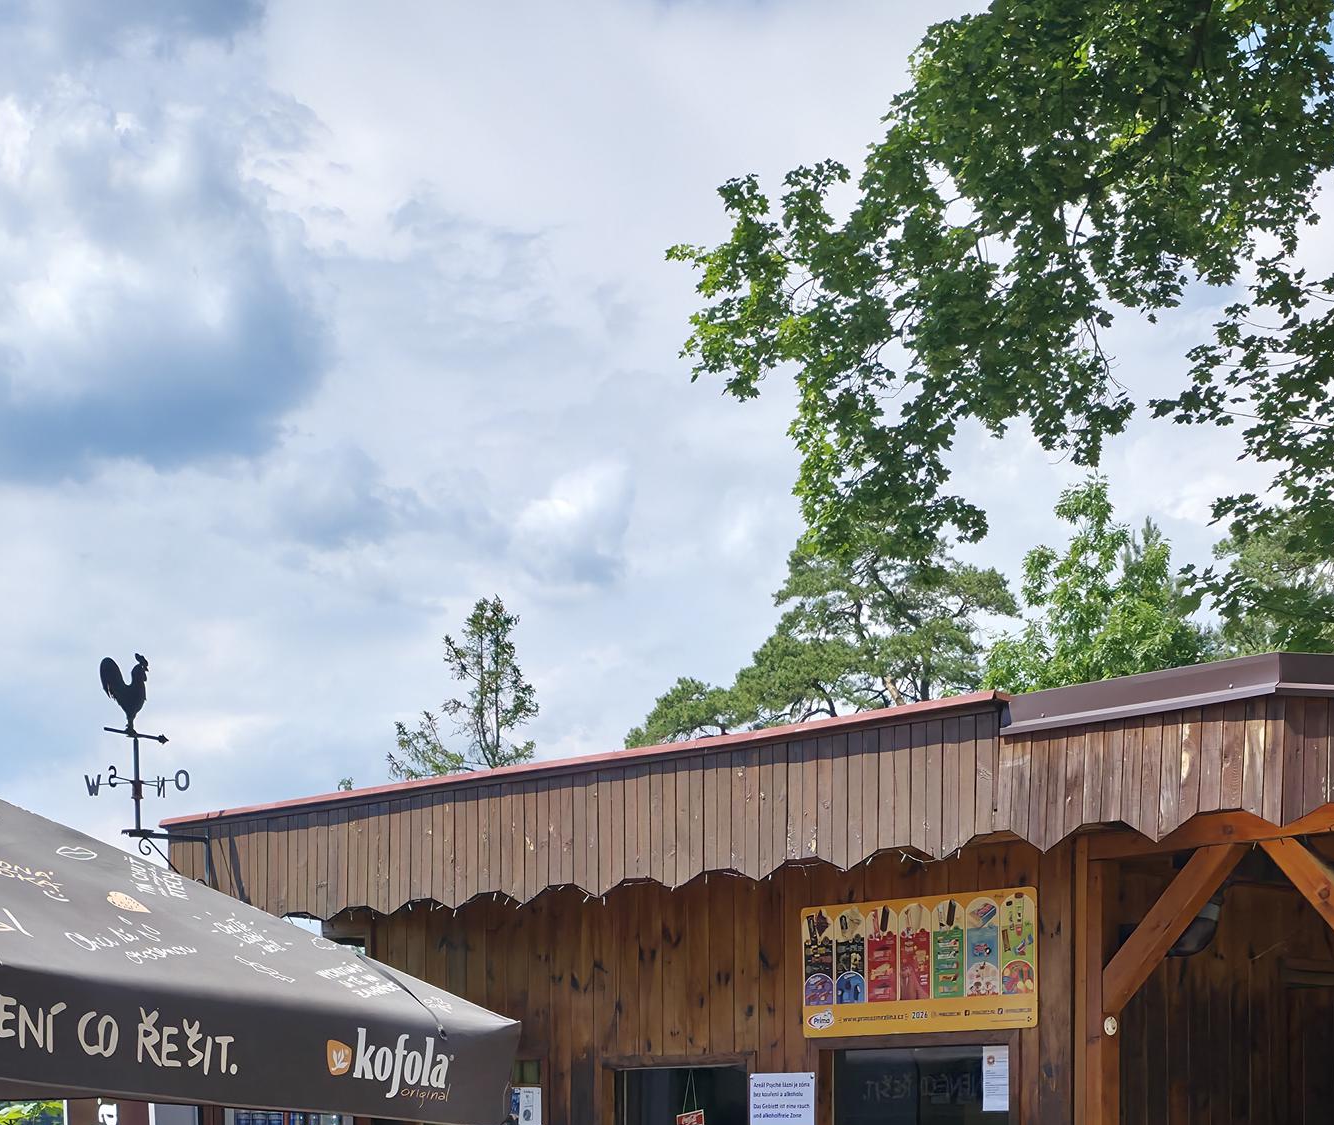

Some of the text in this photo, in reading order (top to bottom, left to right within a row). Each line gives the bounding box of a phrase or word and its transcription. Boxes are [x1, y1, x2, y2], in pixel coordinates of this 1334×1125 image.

[84, 774, 101, 796] W
[78, 1011, 119, 1058] CO
[137, 1007, 239, 1076] ŘEŠIT.
[351, 1027, 453, 1099] kofola
[400, 1082, 451, 1108] original
